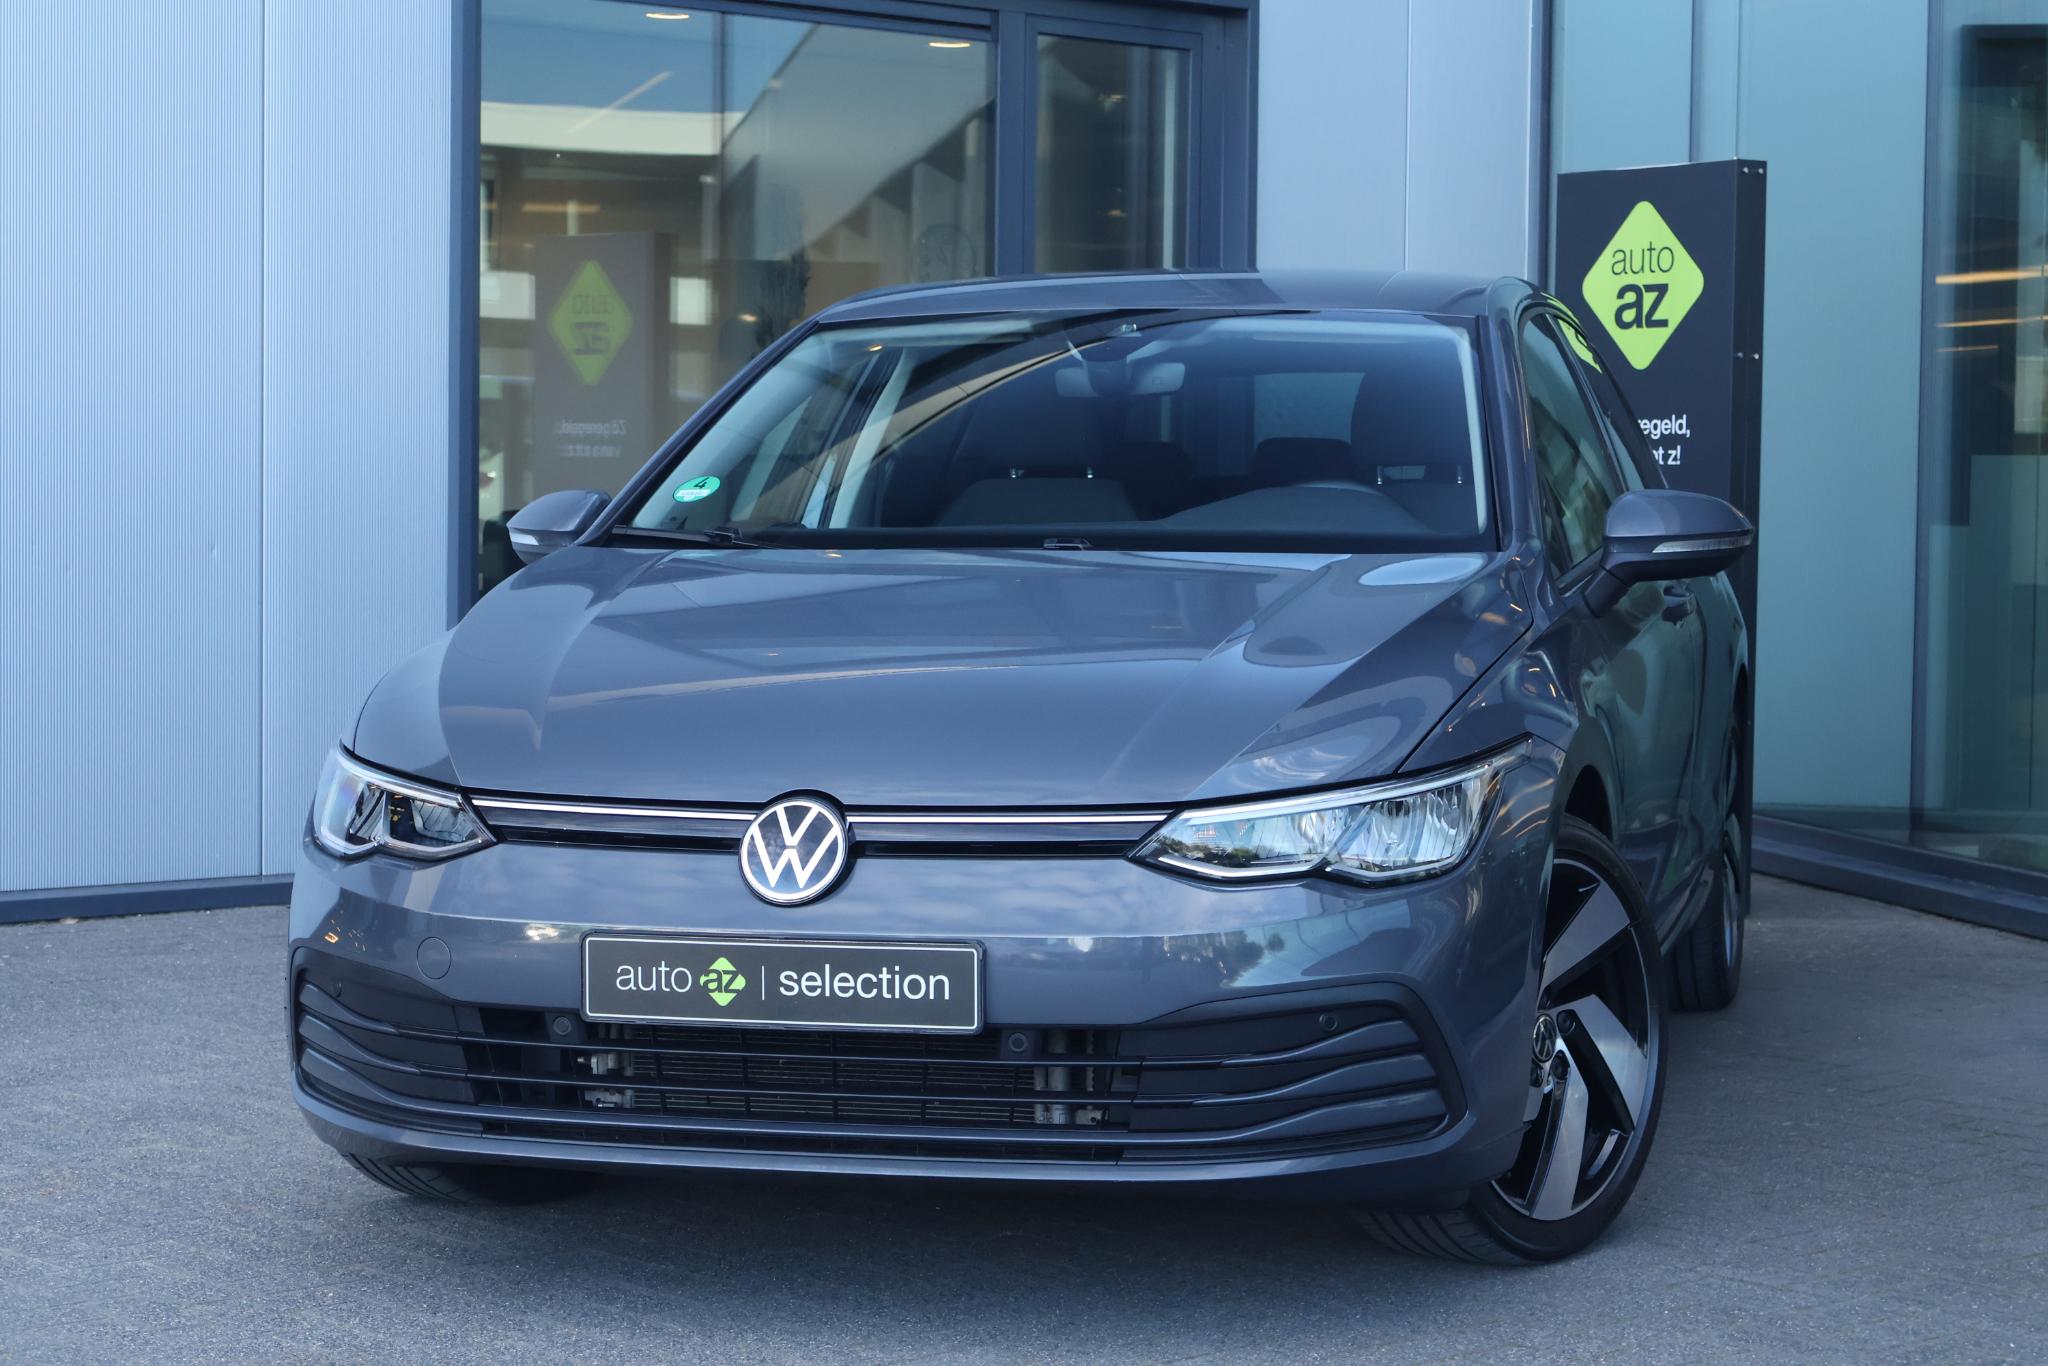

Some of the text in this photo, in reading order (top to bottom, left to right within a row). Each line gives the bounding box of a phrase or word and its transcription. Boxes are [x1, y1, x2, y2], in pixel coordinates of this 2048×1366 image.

[1611, 241, 1675, 275] auto
[1614, 282, 1669, 330] az
[1638, 414, 1691, 439] egeld,
[1667, 445, 1681, 465] z!
[693, 476, 710, 489] 4
[615, 960, 951, 1000] auto az selection
